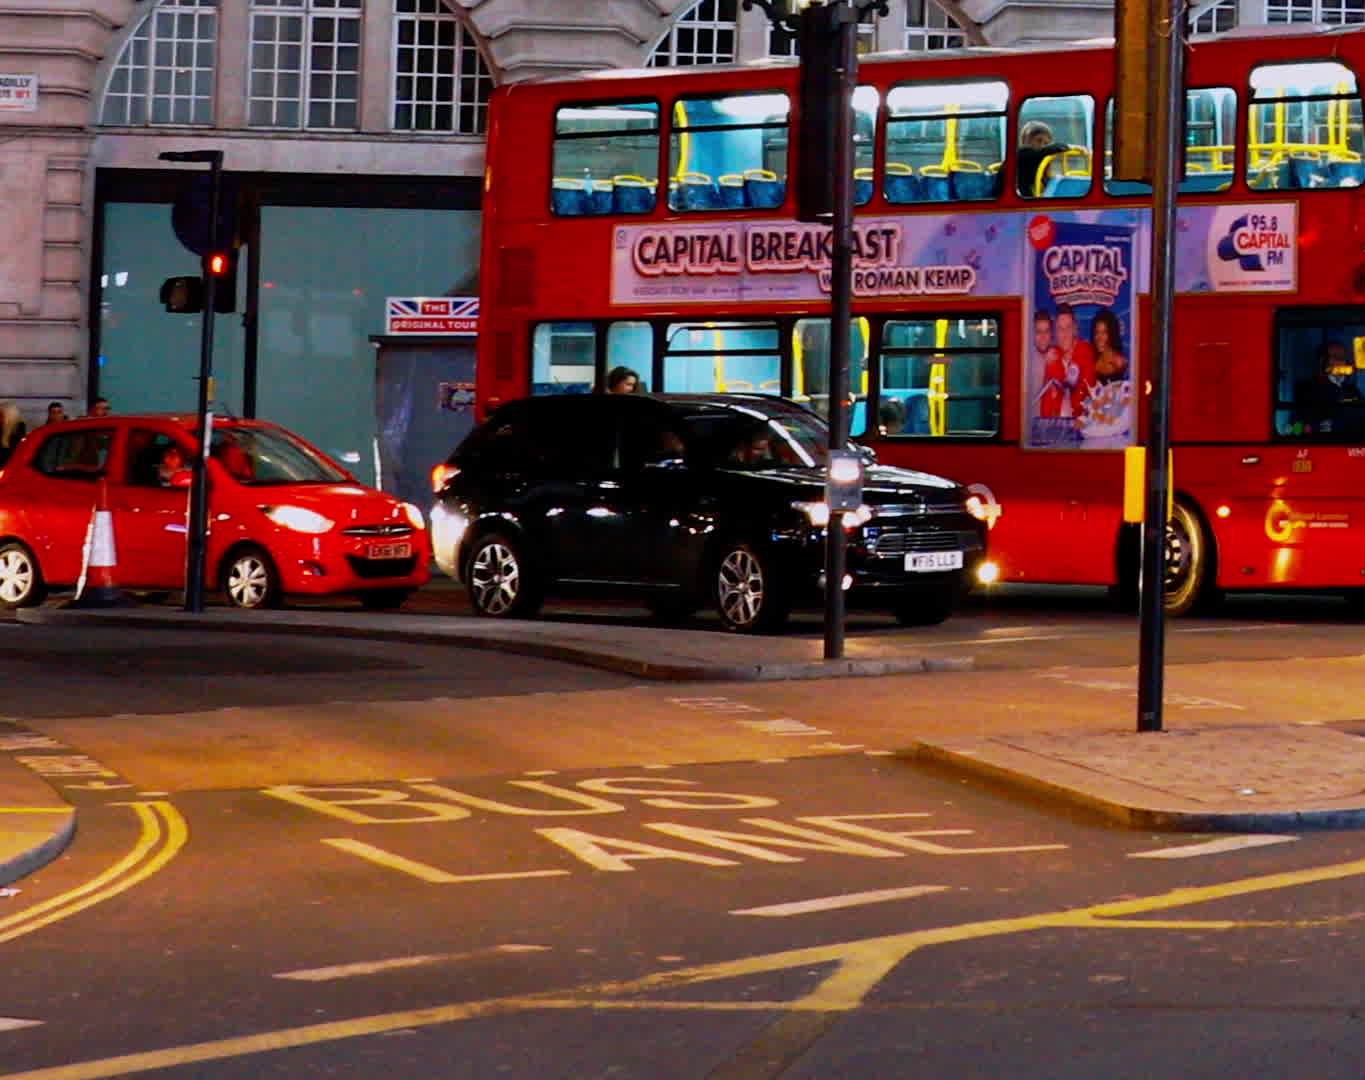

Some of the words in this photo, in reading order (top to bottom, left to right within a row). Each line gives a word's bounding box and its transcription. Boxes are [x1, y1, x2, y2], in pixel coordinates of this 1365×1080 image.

[1250, 214, 1279, 232] 95.8
[636, 230, 739, 266] CAPITAL
[750, 228, 898, 263] BREAKAST
[1237, 232, 1291, 249] CAPITAL
[1046, 248, 1124, 277] CAPITAL
[1266, 250, 1284, 265] FM
[855, 270, 919, 290] ROMAN
[925, 268, 972, 288] KEMP
[1051, 273, 1119, 289] BREAKFAST
[423, 304, 447, 313] THE
[391, 320, 446, 330] ORIGINAL
[447, 320, 477, 330] TOUR
[260, 778, 780, 826] BUS
[320, 811, 1070, 884] LANE
